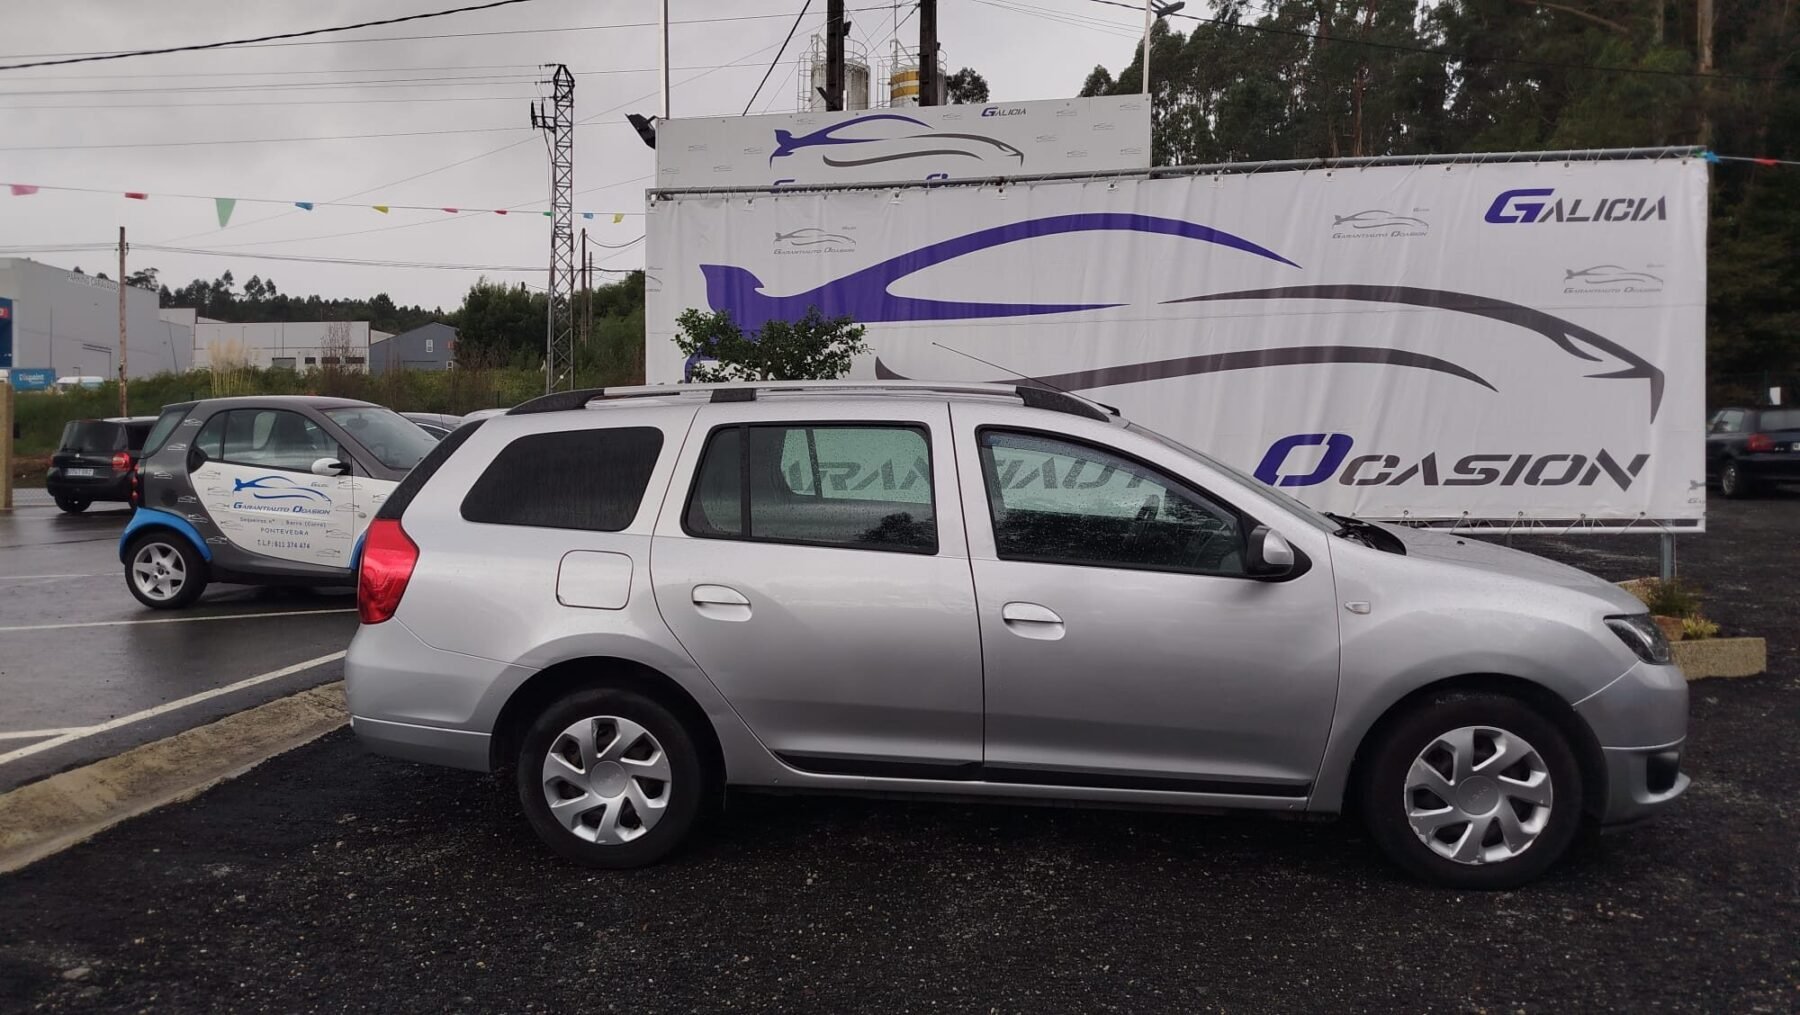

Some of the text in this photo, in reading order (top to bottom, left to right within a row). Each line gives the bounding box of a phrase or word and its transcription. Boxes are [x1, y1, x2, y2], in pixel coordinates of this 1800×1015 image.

[981, 107, 1027, 117] GALICIA
[1484, 188, 1667, 224] GALICIA
[1252, 433, 1651, 492] OCASION
[260, 527, 310, 536] PONTEVEDRA
